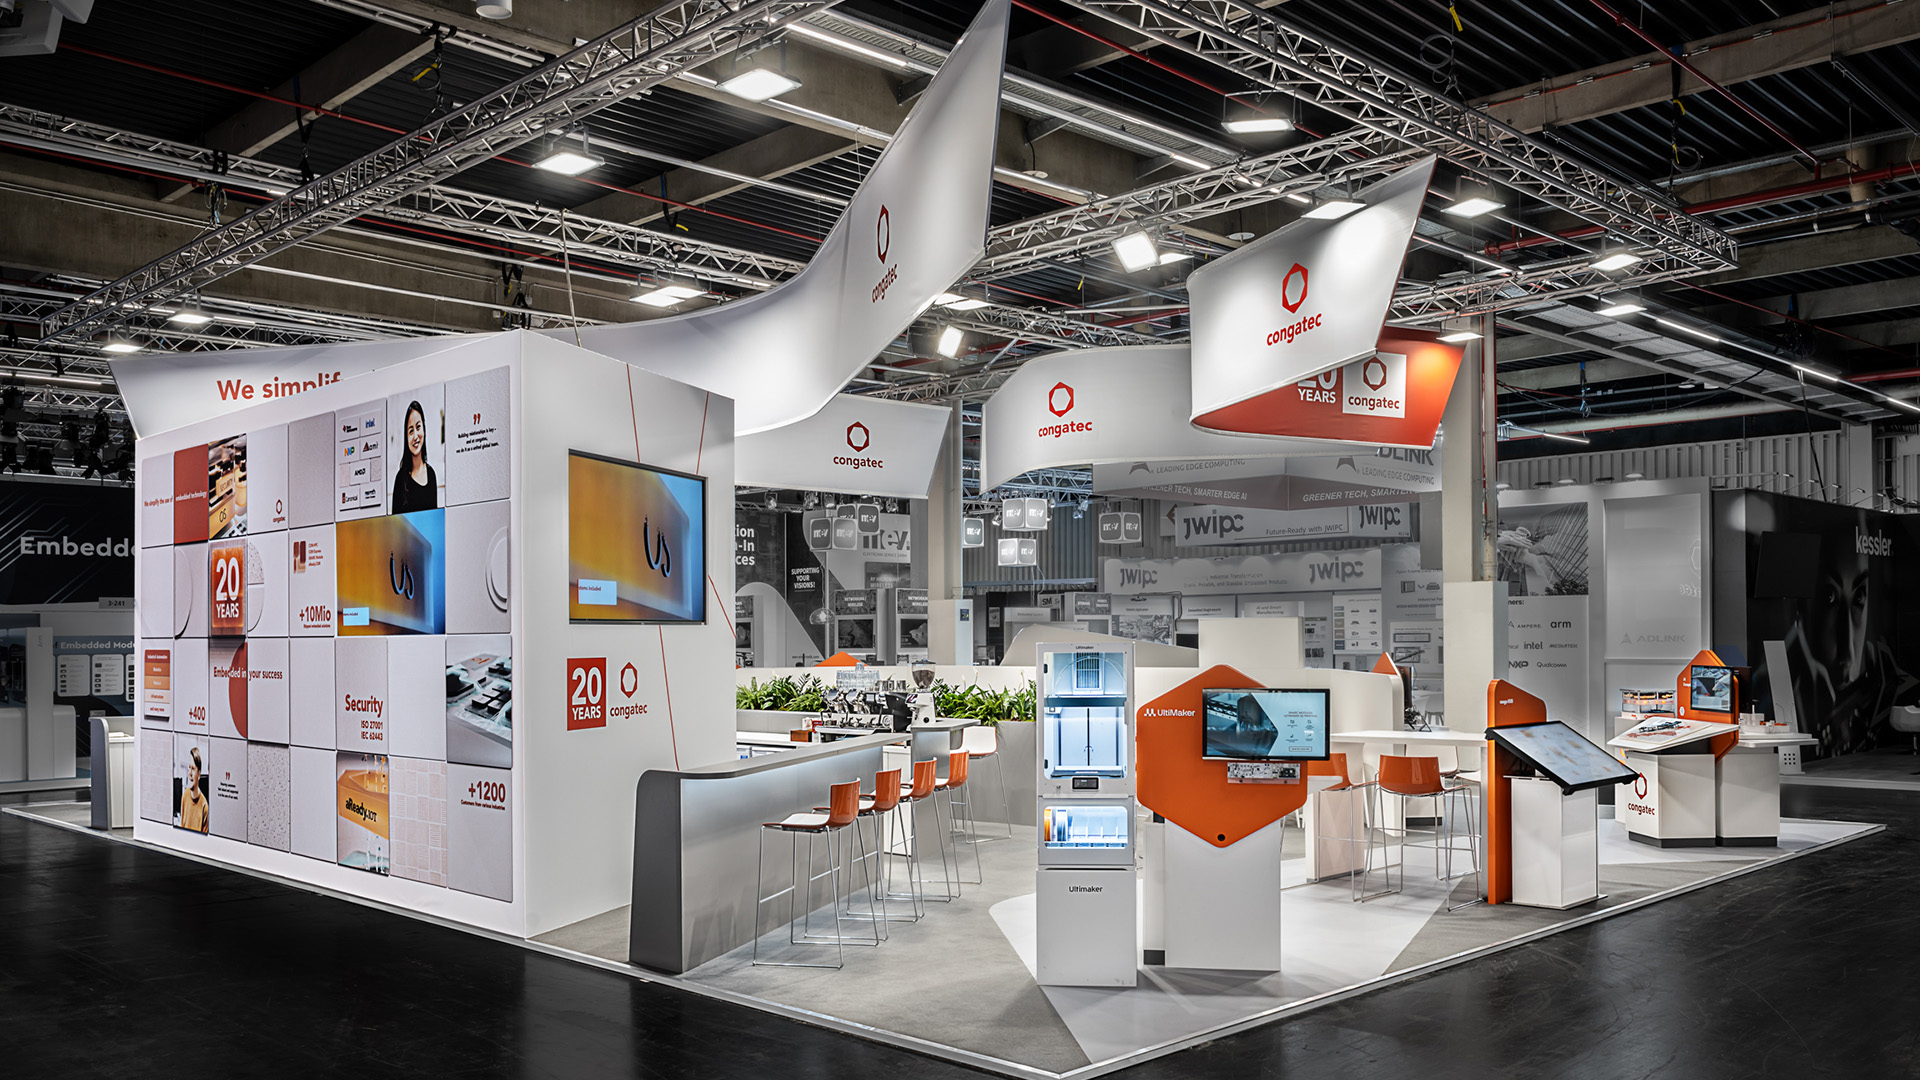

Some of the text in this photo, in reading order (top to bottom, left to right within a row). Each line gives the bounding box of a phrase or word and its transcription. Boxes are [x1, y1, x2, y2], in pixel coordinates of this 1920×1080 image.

[872, 264, 898, 303] congatec
[1266, 313, 1322, 346] congatec
[216, 371, 341, 400] We simplif
[1298, 368, 1338, 390] 0
[1298, 388, 1336, 404] YEARS
[1348, 396, 1400, 410] congatec
[1038, 420, 1092, 438] congatec
[832, 455, 884, 469] congatec
[1375, 447, 1434, 466] DLINK
[1156, 459, 1245, 474] LEADING EDGE COMPUTING
[1362, 467, 1434, 485] LEADING EDGE COMPUTING
[1174, 485, 1192, 496] TECH,
[1194, 487, 1223, 498] SMARTER
[1223, 491, 1240, 500] EDGE
[1303, 488, 1416, 502] GREENER TECH, SMART
[1266, 526, 1307, 535] Future-Ready
[1324, 524, 1343, 532] JWIPC
[216, 557, 240, 600] 20
[791, 567, 820, 575] SUPPORTING
[216, 604, 240, 618] YEARS
[299, 604, 332, 622] +10Mio
[60, 641, 111, 649] Embedded
[113, 641, 135, 649] Mod
[1524, 641, 1543, 649] intel
[213, 666, 283, 681] Embedded in your success
[572, 666, 602, 705] 20
[189, 706, 206, 721] +400
[345, 694, 384, 718] Security
[572, 705, 601, 721] YEARS
[610, 703, 648, 719] congatec
[1157, 709, 1196, 717] UltiMaker
[361, 720, 383, 730] ISO 27001
[361, 731, 383, 741] IEC 62443
[468, 780, 506, 803] +1200
[1628, 802, 1655, 815] congatec
